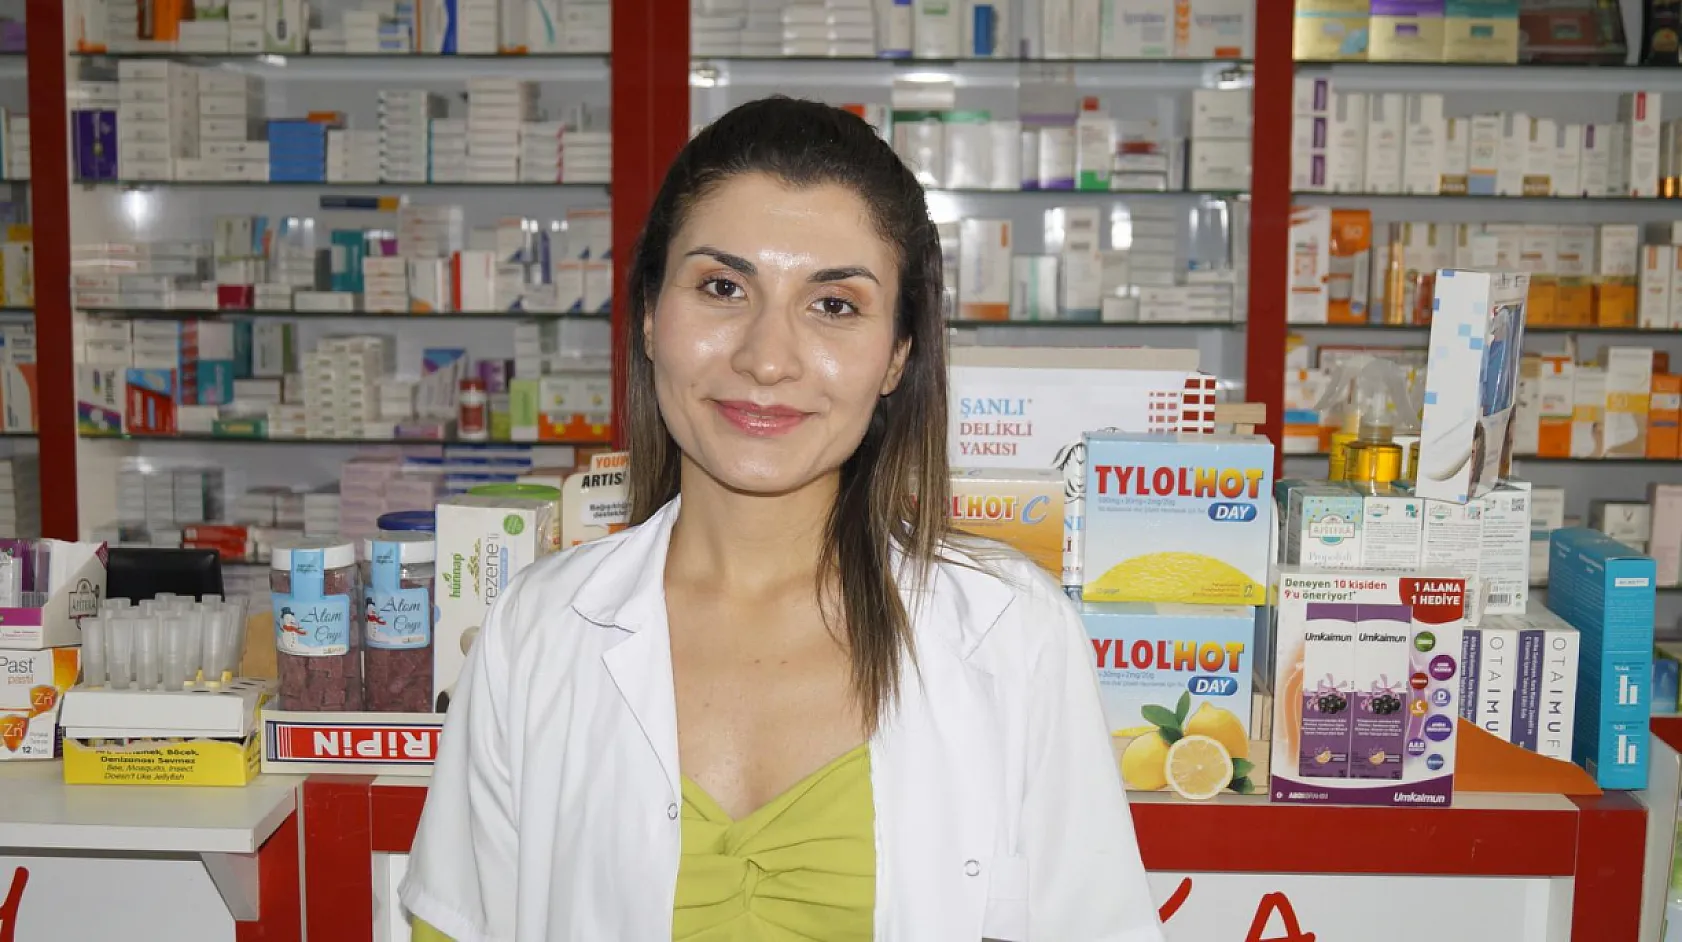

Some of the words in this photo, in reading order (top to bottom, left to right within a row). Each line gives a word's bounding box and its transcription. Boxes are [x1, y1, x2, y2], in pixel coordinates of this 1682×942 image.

[960, 398, 1025, 418] ŞANLI
[960, 420, 1032, 436] DELİKLİ
[960, 441, 1017, 456] YAKISI
[1215, 505, 1249, 520] DAY
[1285, 578, 1331, 589] Deneyen
[1334, 580, 1346, 589] 10
[1349, 580, 1388, 591] kişiden
[1414, 582, 1420, 592] 1
[1422, 583, 1461, 593] ALANA
[1411, 595, 1417, 604] 1
[1420, 594, 1461, 605] HEDİYE
[1305, 633, 1352, 641] Umkaimun
[1358, 633, 1407, 642] Umkaimun
[1091, 638, 1244, 673] YLOLHOT
[0, 656, 33, 674] Past
[1196, 680, 1230, 693] DAY
[1546, 636, 1567, 758] OTAIMUF
[313, 731, 438, 757] RiPiN
[153, 773, 185, 781] Jellyfish
[1393, 791, 1445, 803] Umkaimun
